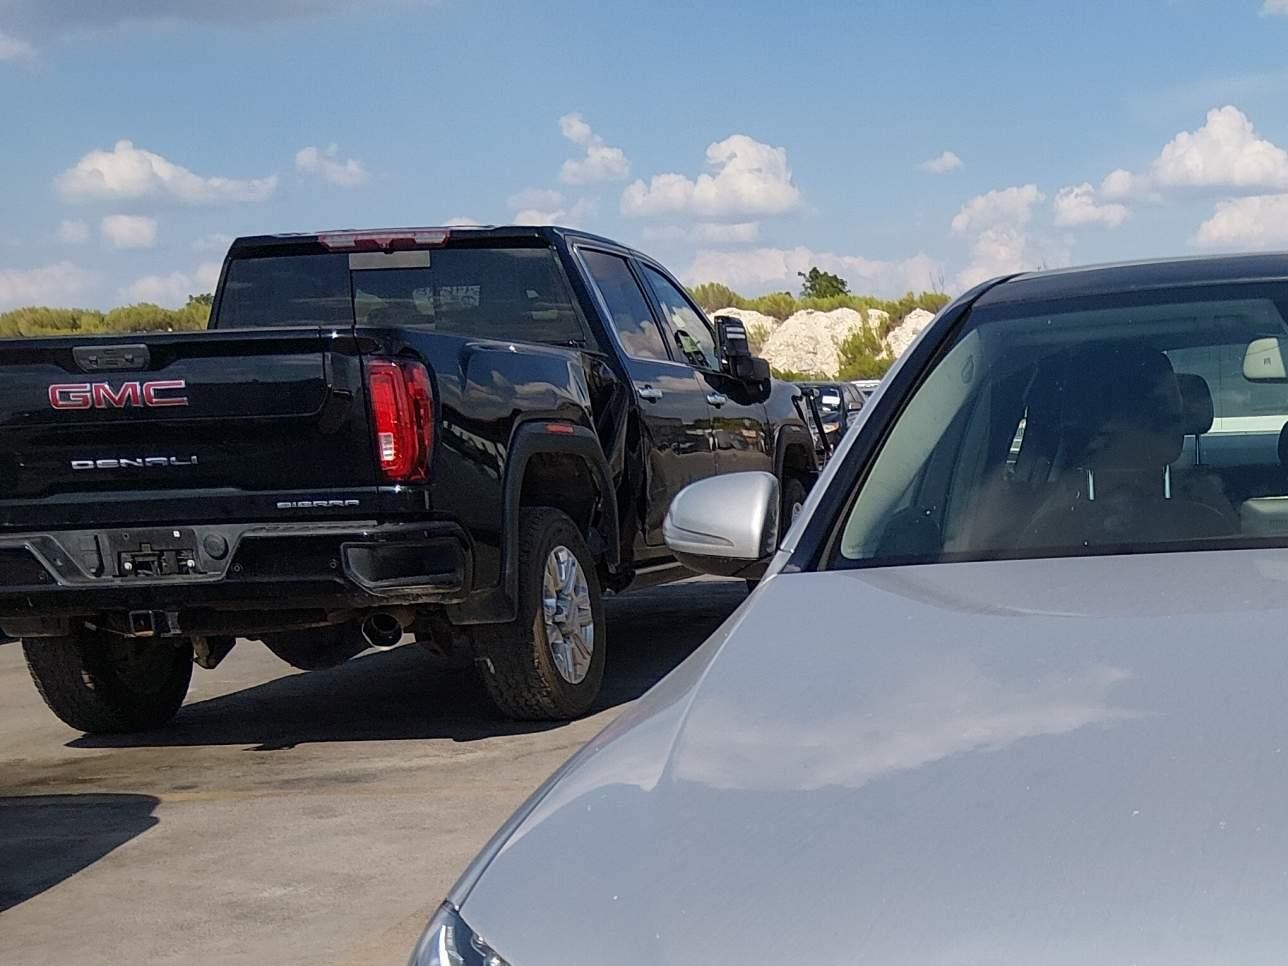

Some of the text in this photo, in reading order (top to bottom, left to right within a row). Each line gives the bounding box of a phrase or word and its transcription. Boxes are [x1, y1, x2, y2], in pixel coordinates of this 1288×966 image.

[48, 379, 189, 410] GMC
[71, 455, 198, 470] DENALI
[276, 499, 360, 509] SIERRA
